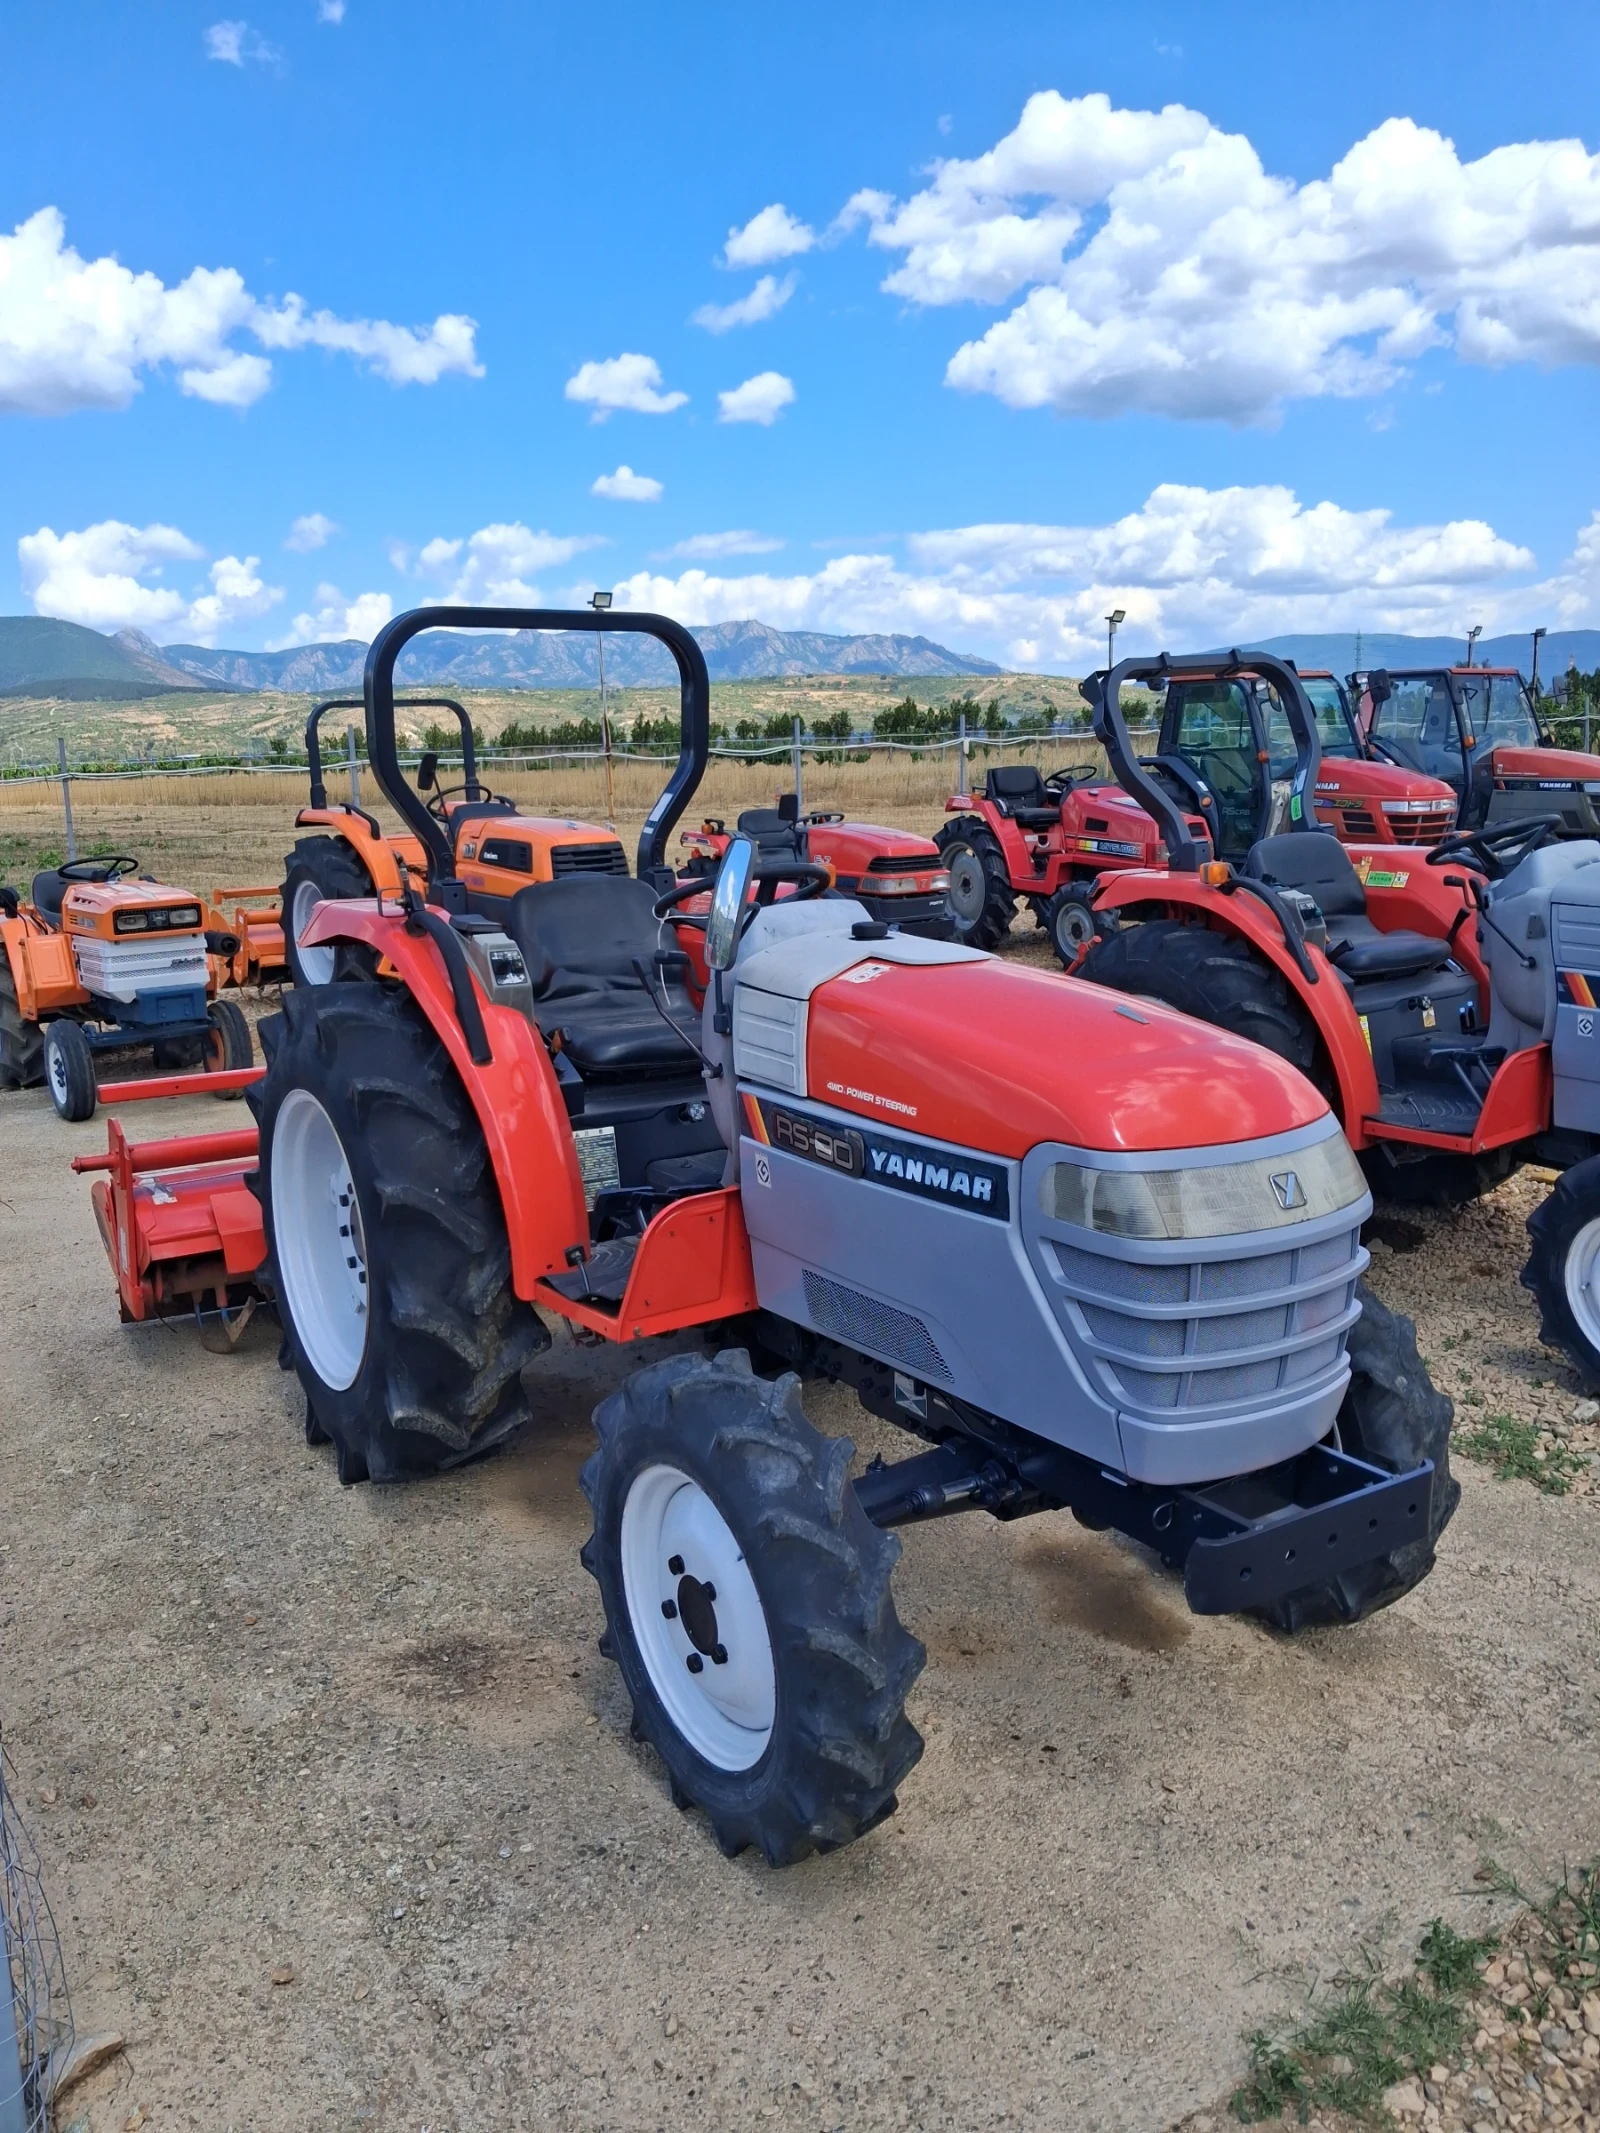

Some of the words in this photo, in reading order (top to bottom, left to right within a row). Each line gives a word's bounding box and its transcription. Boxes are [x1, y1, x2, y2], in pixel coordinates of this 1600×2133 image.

[846, 1087, 874, 1103] POWER
[875, 1096, 917, 1117] STEERING
[870, 1148, 993, 1202] YANMAR
